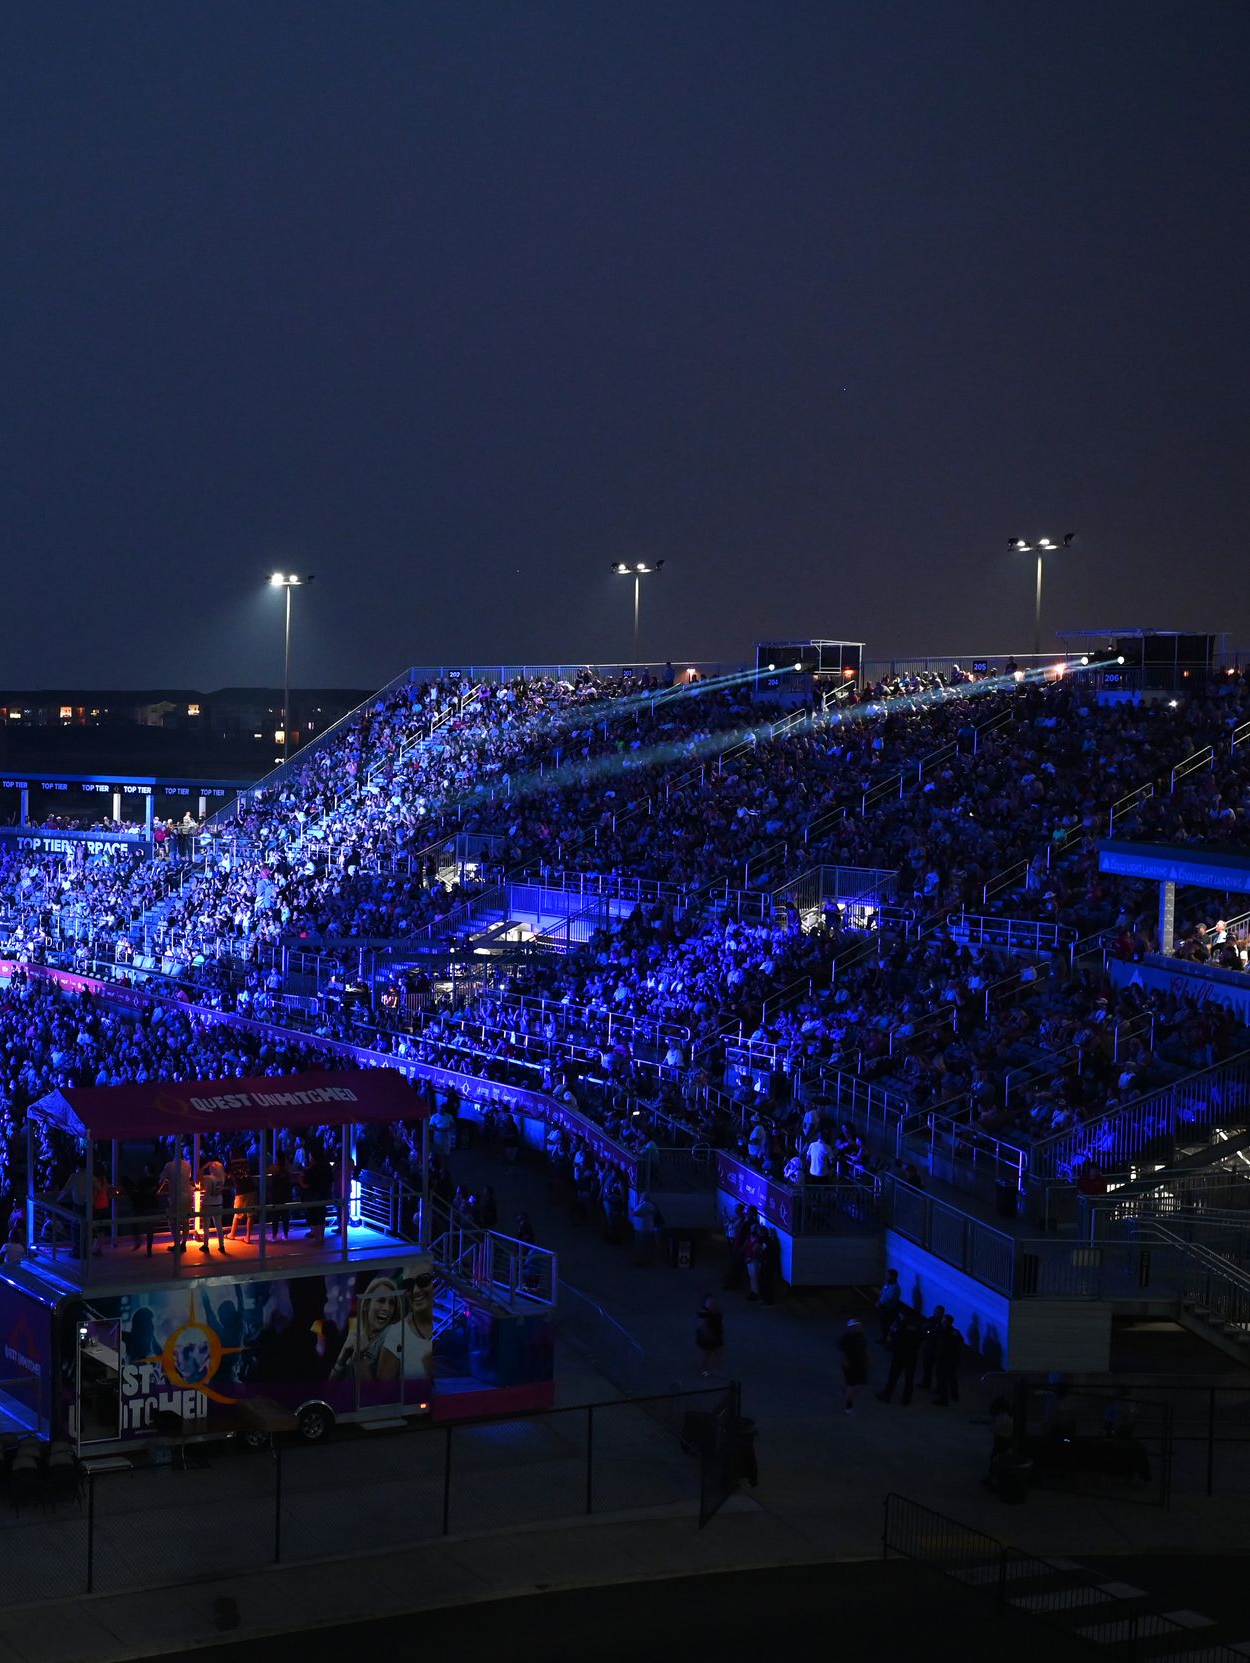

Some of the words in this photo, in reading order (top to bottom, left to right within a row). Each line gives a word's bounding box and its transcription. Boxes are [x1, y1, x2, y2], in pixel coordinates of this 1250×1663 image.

[973, 663, 987, 671] 205
[1104, 674, 1119, 682] 206
[17, 837, 41, 850] TOP
[43, 839, 69, 853] TIER
[190, 1093, 252, 1112] QUEST
[250, 1087, 358, 1107] UNHITCHED
